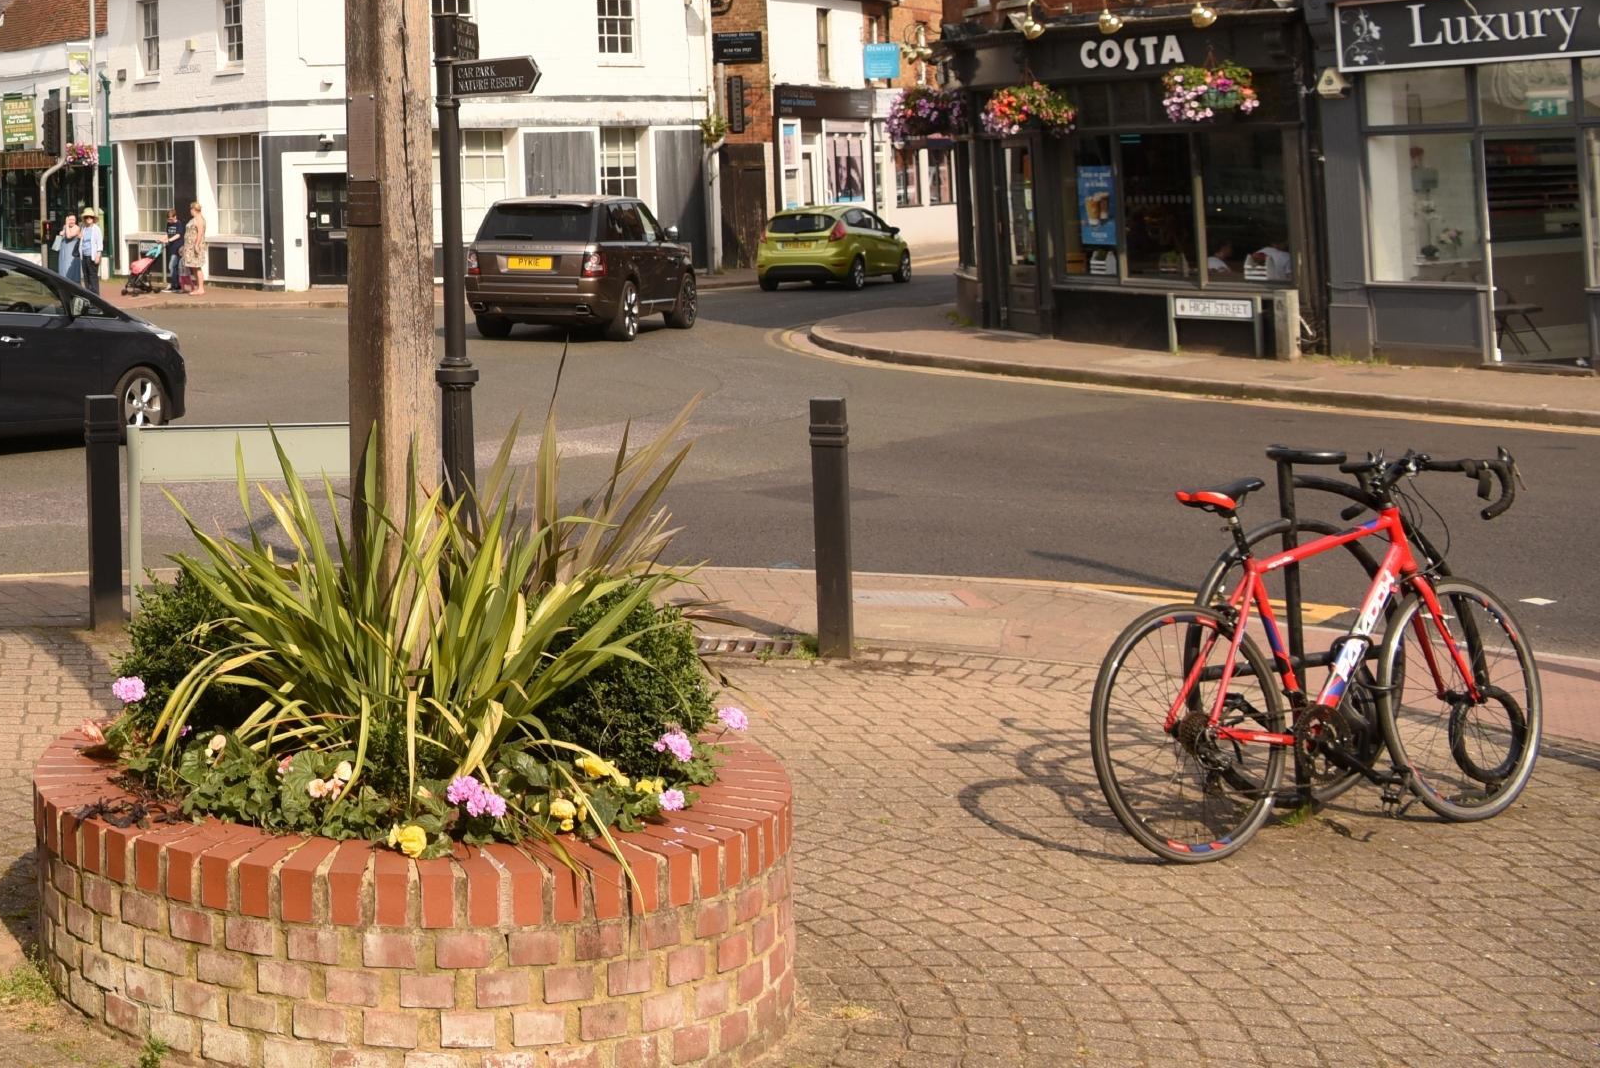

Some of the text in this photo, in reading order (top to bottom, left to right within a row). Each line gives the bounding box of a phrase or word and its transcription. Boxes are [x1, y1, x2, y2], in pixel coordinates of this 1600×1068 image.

[1405, 3, 1583, 52] Luxury
[1080, 35, 1185, 71] COSTA
[457, 65, 497, 79] CAR PARK
[458, 75, 524, 91] NATURE RESERVE
[1188, 302, 1248, 315] HIGH STREET
